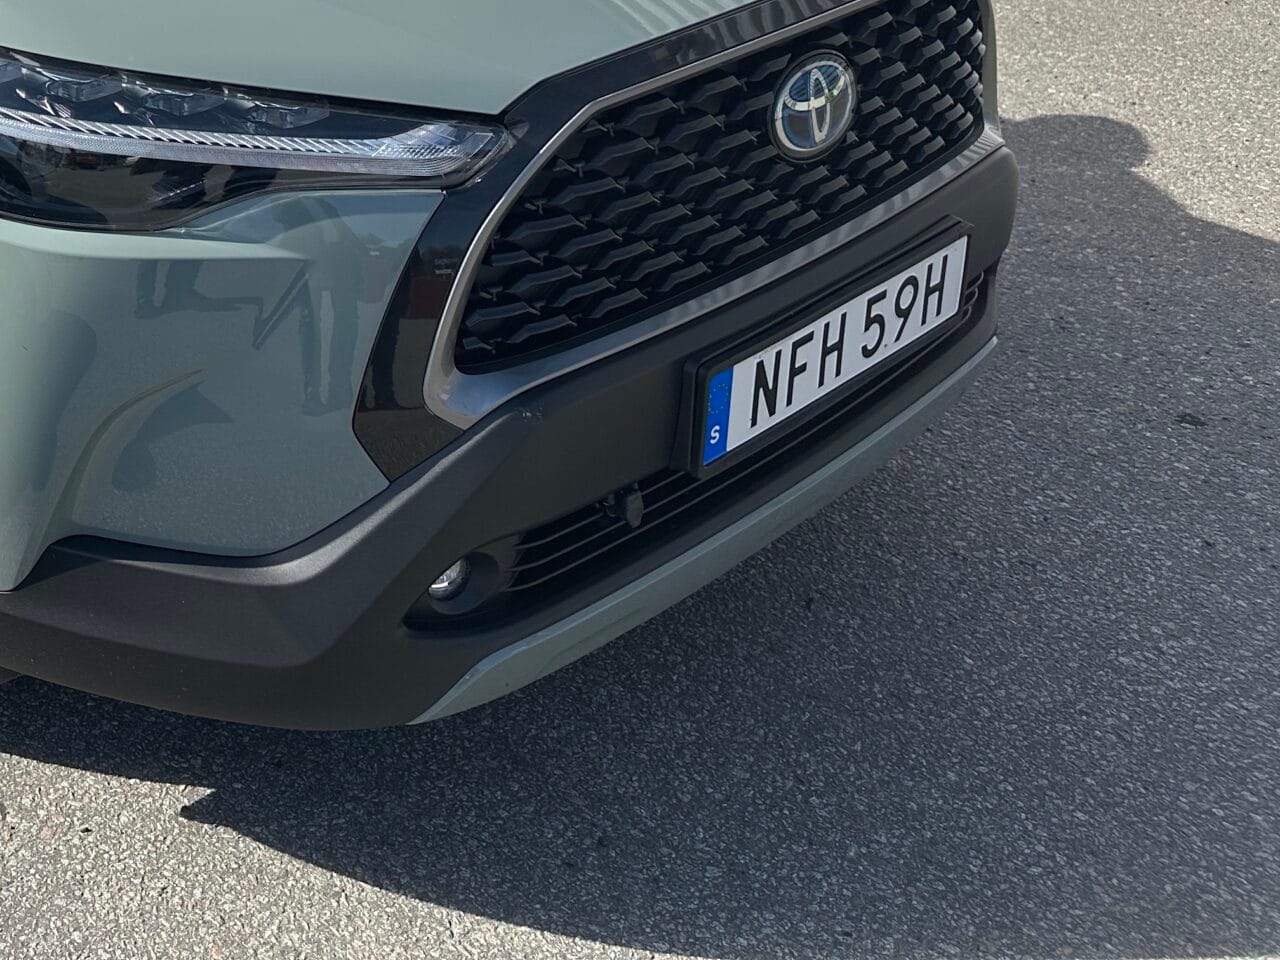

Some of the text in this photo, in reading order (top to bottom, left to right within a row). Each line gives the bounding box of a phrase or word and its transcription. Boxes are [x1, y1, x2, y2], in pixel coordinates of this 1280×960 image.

[751, 254, 949, 428] NFH 59H
[710, 425, 720, 444] S
